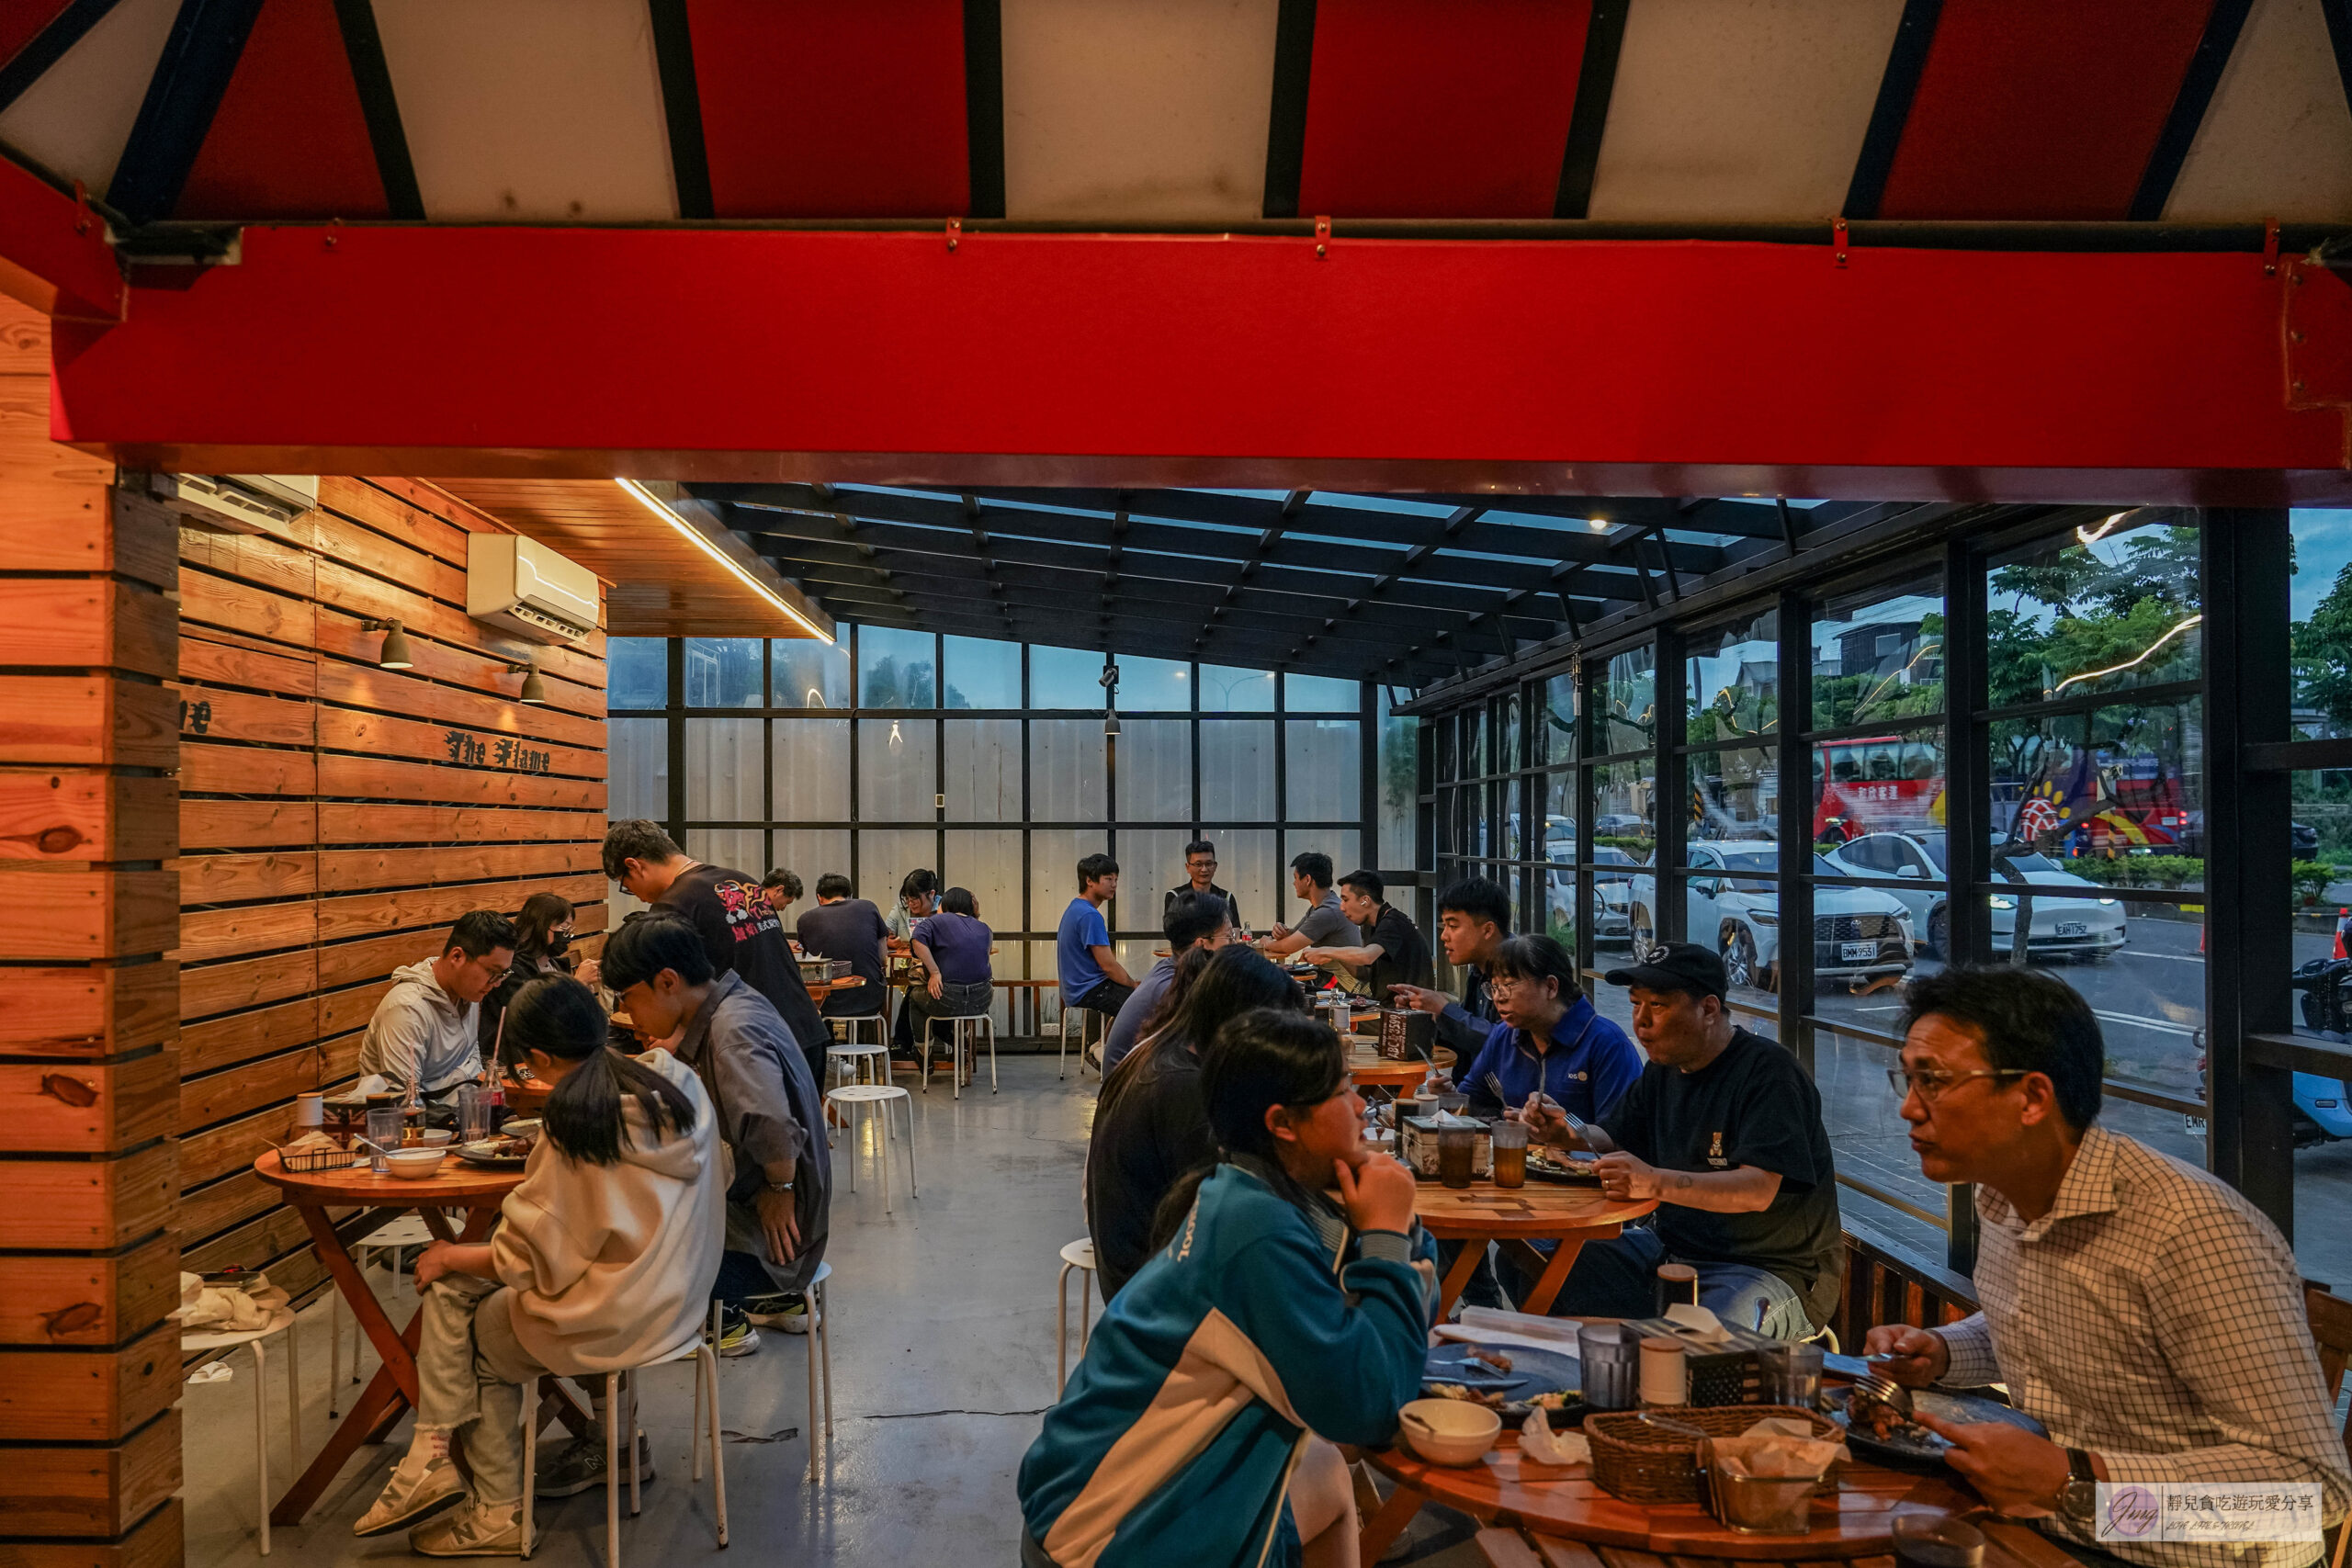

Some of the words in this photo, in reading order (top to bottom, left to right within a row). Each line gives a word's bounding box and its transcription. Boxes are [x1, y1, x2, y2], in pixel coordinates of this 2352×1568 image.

[444, 730, 486, 764] The
[492, 739, 550, 773] Flame
[1387, 1042, 1400, 1059] ABC
[451, 1523, 478, 1544] N
